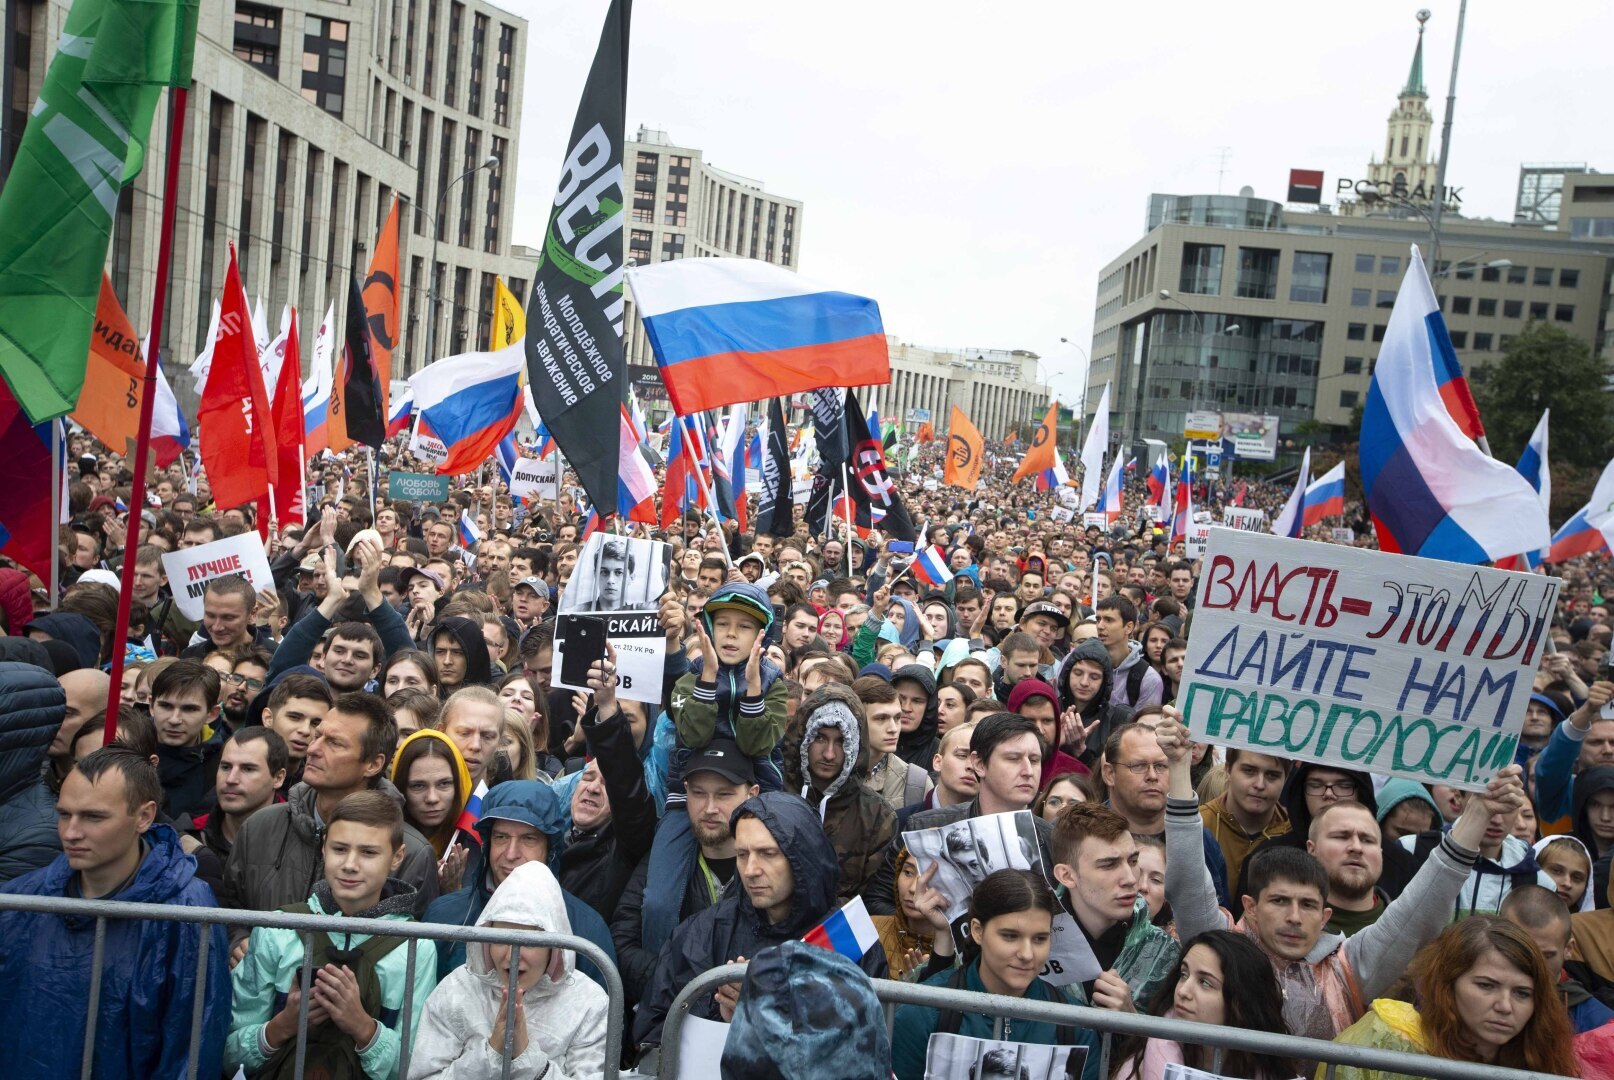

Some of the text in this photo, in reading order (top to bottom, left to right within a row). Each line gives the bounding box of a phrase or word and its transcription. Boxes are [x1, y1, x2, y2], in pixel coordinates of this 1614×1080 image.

[536, 281, 595, 394] демократическое
[556, 294, 613, 382] Молодёжное
[536, 338, 578, 406] движение
[642, 373, 658, 381] 2019
[396, 478, 440, 488] ЛЮБОВЬ
[514, 471, 556, 484] ДОПУСКАЙ
[402, 487, 442, 496] СОБОЛЬ
[187, 554, 242, 581] ЛУЧШЕ
[608, 616, 658, 633] СКАЙ!
[645, 647, 655, 655] РФ
[1194, 624, 1518, 728] ДАЙТЕ НАМ
